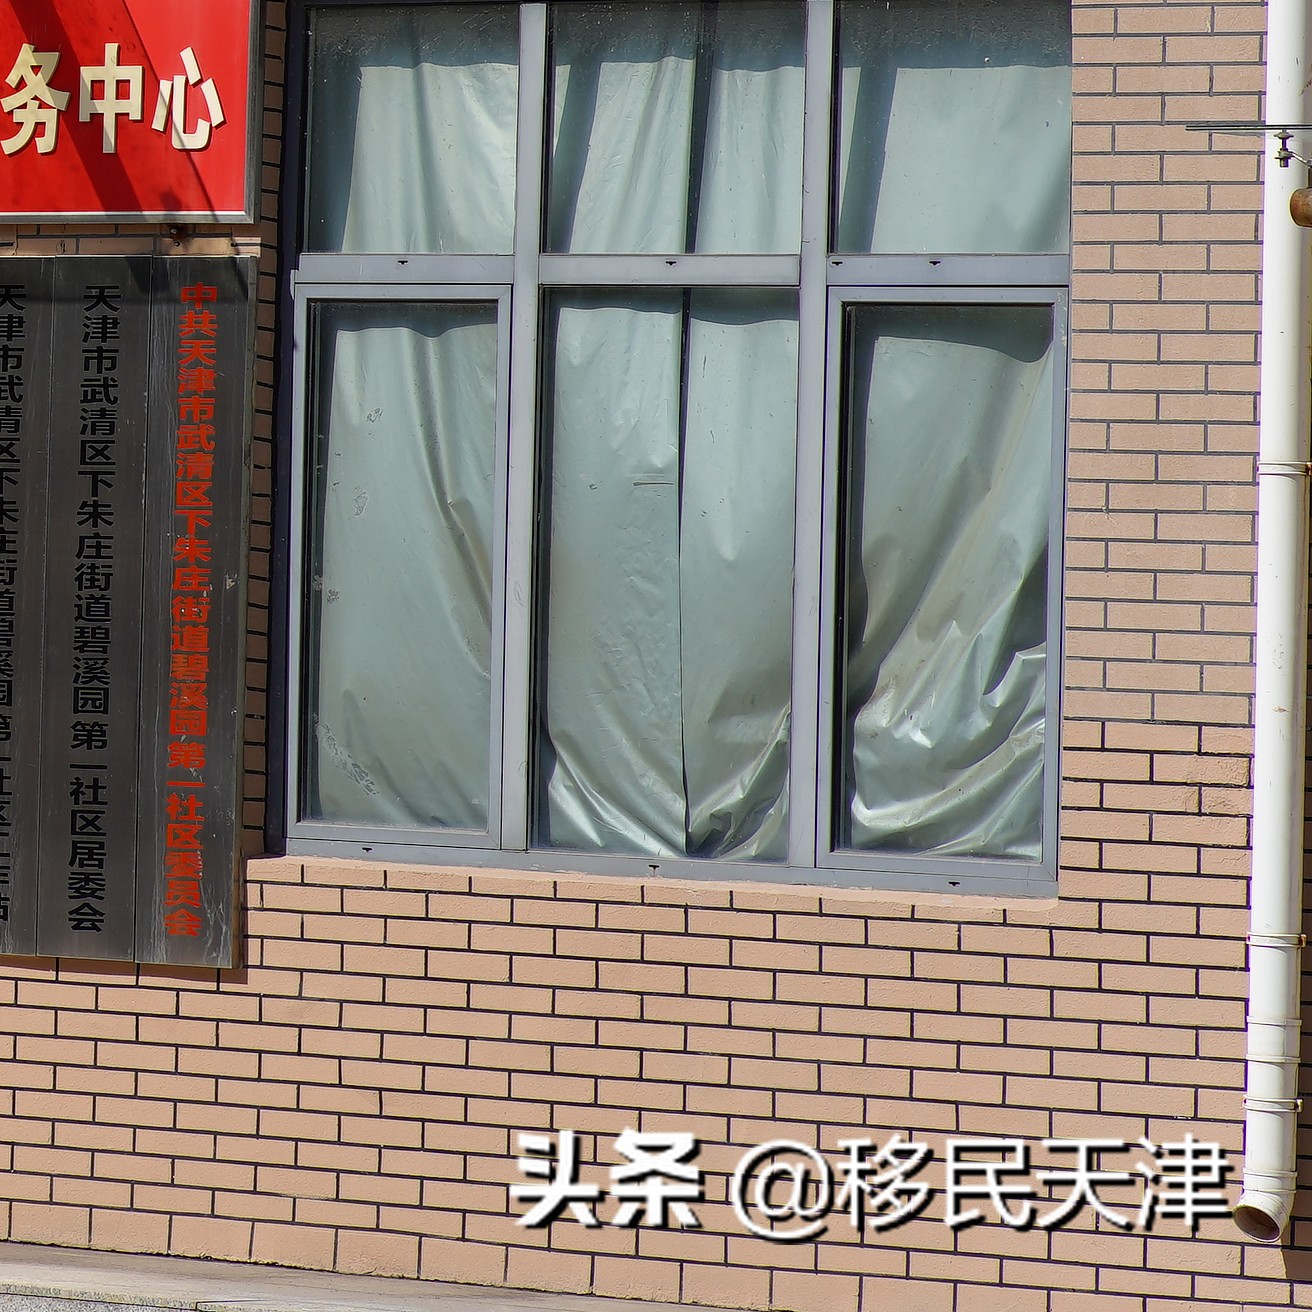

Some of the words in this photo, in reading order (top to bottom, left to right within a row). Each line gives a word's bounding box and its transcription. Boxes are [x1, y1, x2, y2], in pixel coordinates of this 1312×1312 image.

[67, 284, 122, 933] 天津市武清区下朱庄街道碧溪园第一社区居委会
[163, 282, 219, 937] 中共天津市武清区下朱庄街道碧溪园第一社区委员会
